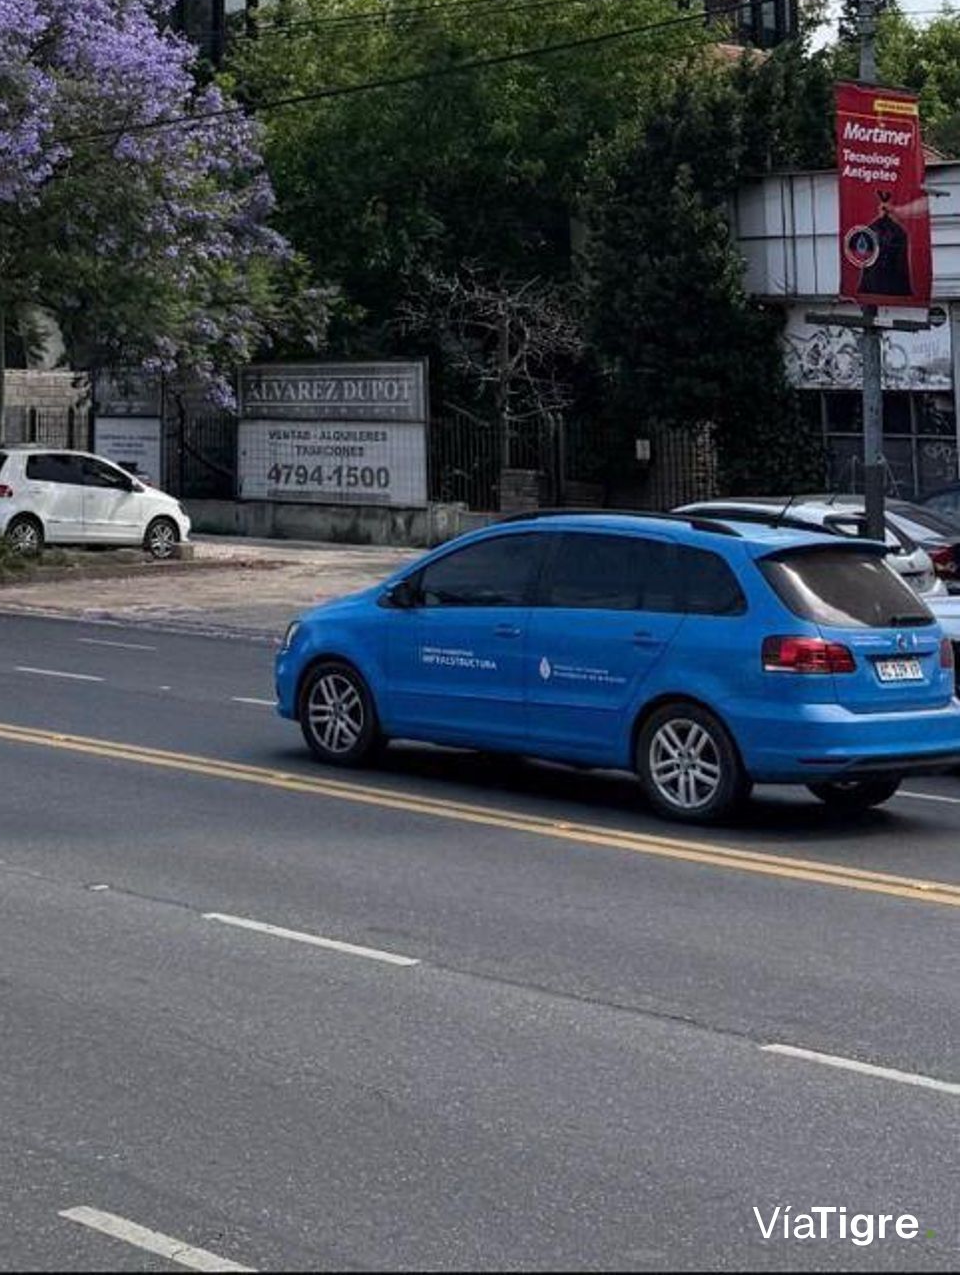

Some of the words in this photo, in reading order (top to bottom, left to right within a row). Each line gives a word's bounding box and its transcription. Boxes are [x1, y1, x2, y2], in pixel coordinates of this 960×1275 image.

[843, 121, 912, 146] Mortimer
[842, 165, 898, 183] Antigoteo
[268, 430, 312, 441] VENTAS
[321, 430, 388, 442] ALQUILERES
[267, 463, 390, 488] 4794-1500
